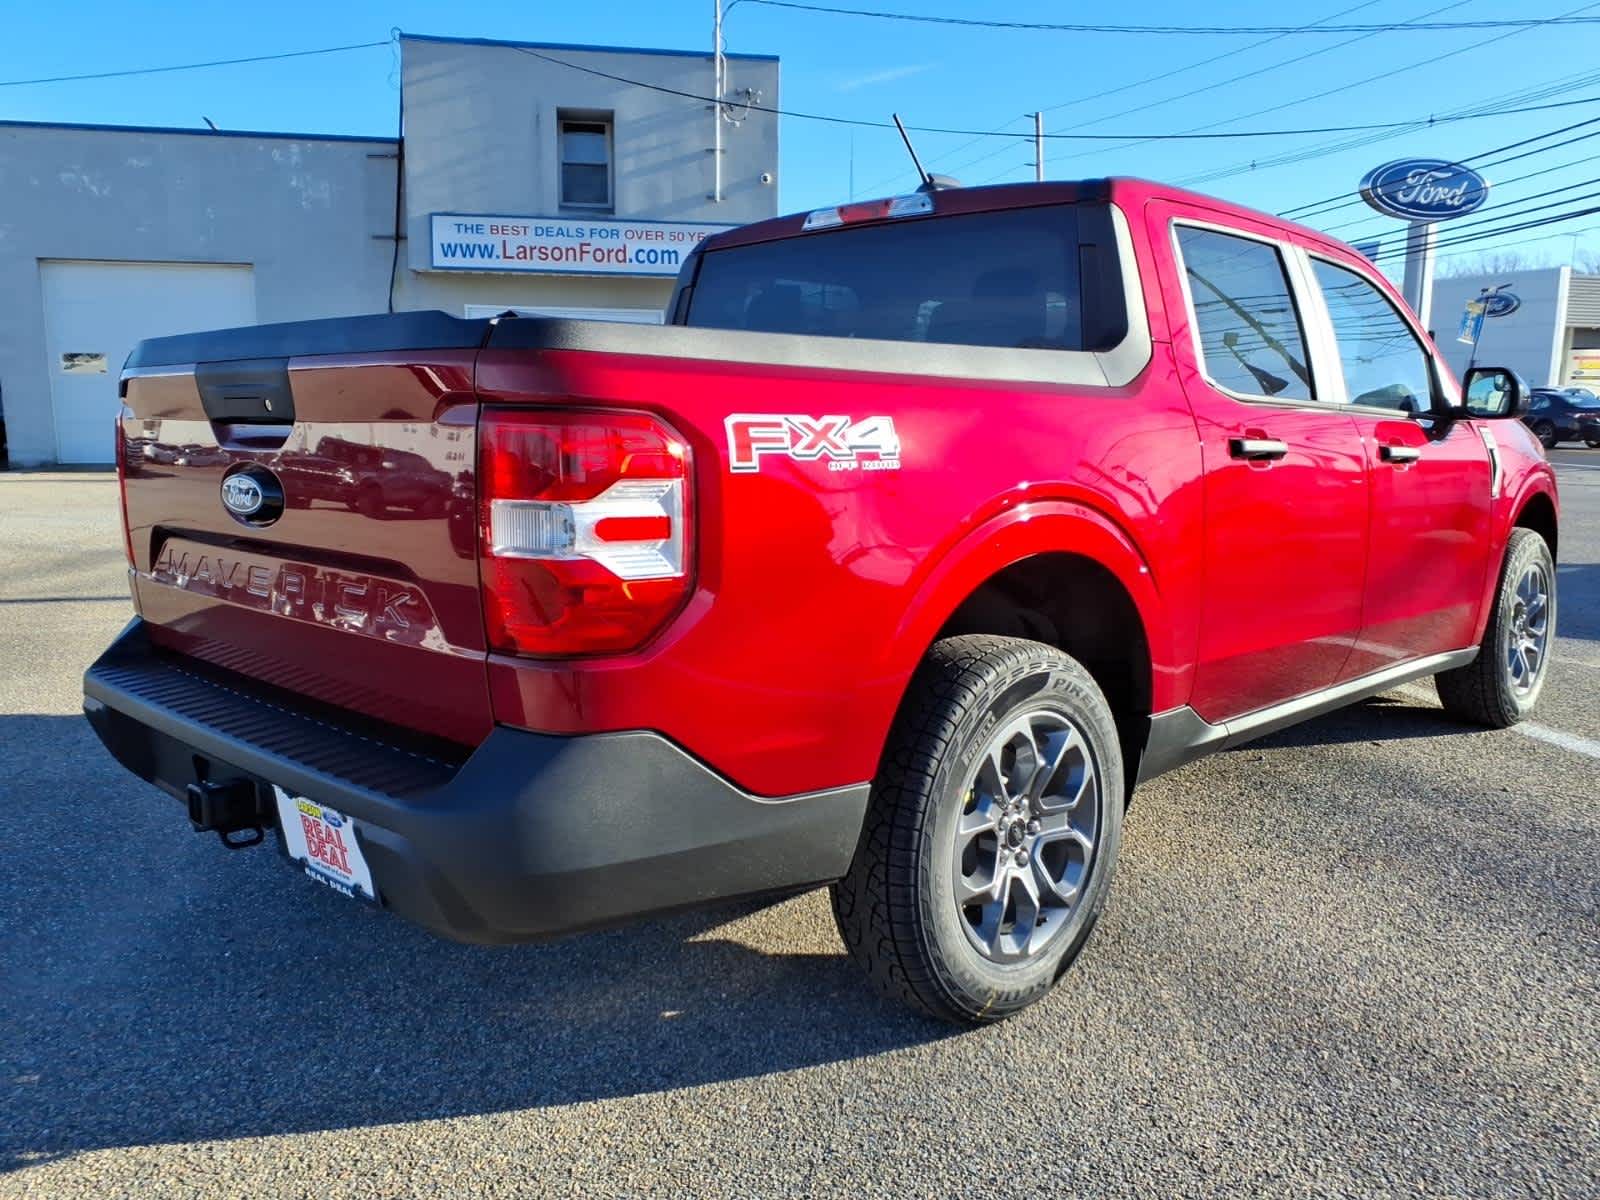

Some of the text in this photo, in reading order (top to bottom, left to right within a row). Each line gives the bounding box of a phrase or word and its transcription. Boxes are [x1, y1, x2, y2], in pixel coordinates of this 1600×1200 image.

[1399, 169, 1468, 206] Ford
[453, 223, 486, 235] THE
[489, 224, 529, 236] BEST
[534, 225, 585, 238] DEALS
[589, 227, 620, 240] FOR
[624, 229, 665, 241] OVER
[668, 231, 685, 242] 50
[439, 239, 679, 265] www.LarsonFord.com
[724, 413, 900, 473] FX4
[228, 484, 253, 506] Ford
[154, 542, 412, 629] MAVERICK
[301, 814, 348, 853] REAL
[306, 836, 353, 876] DEAL
